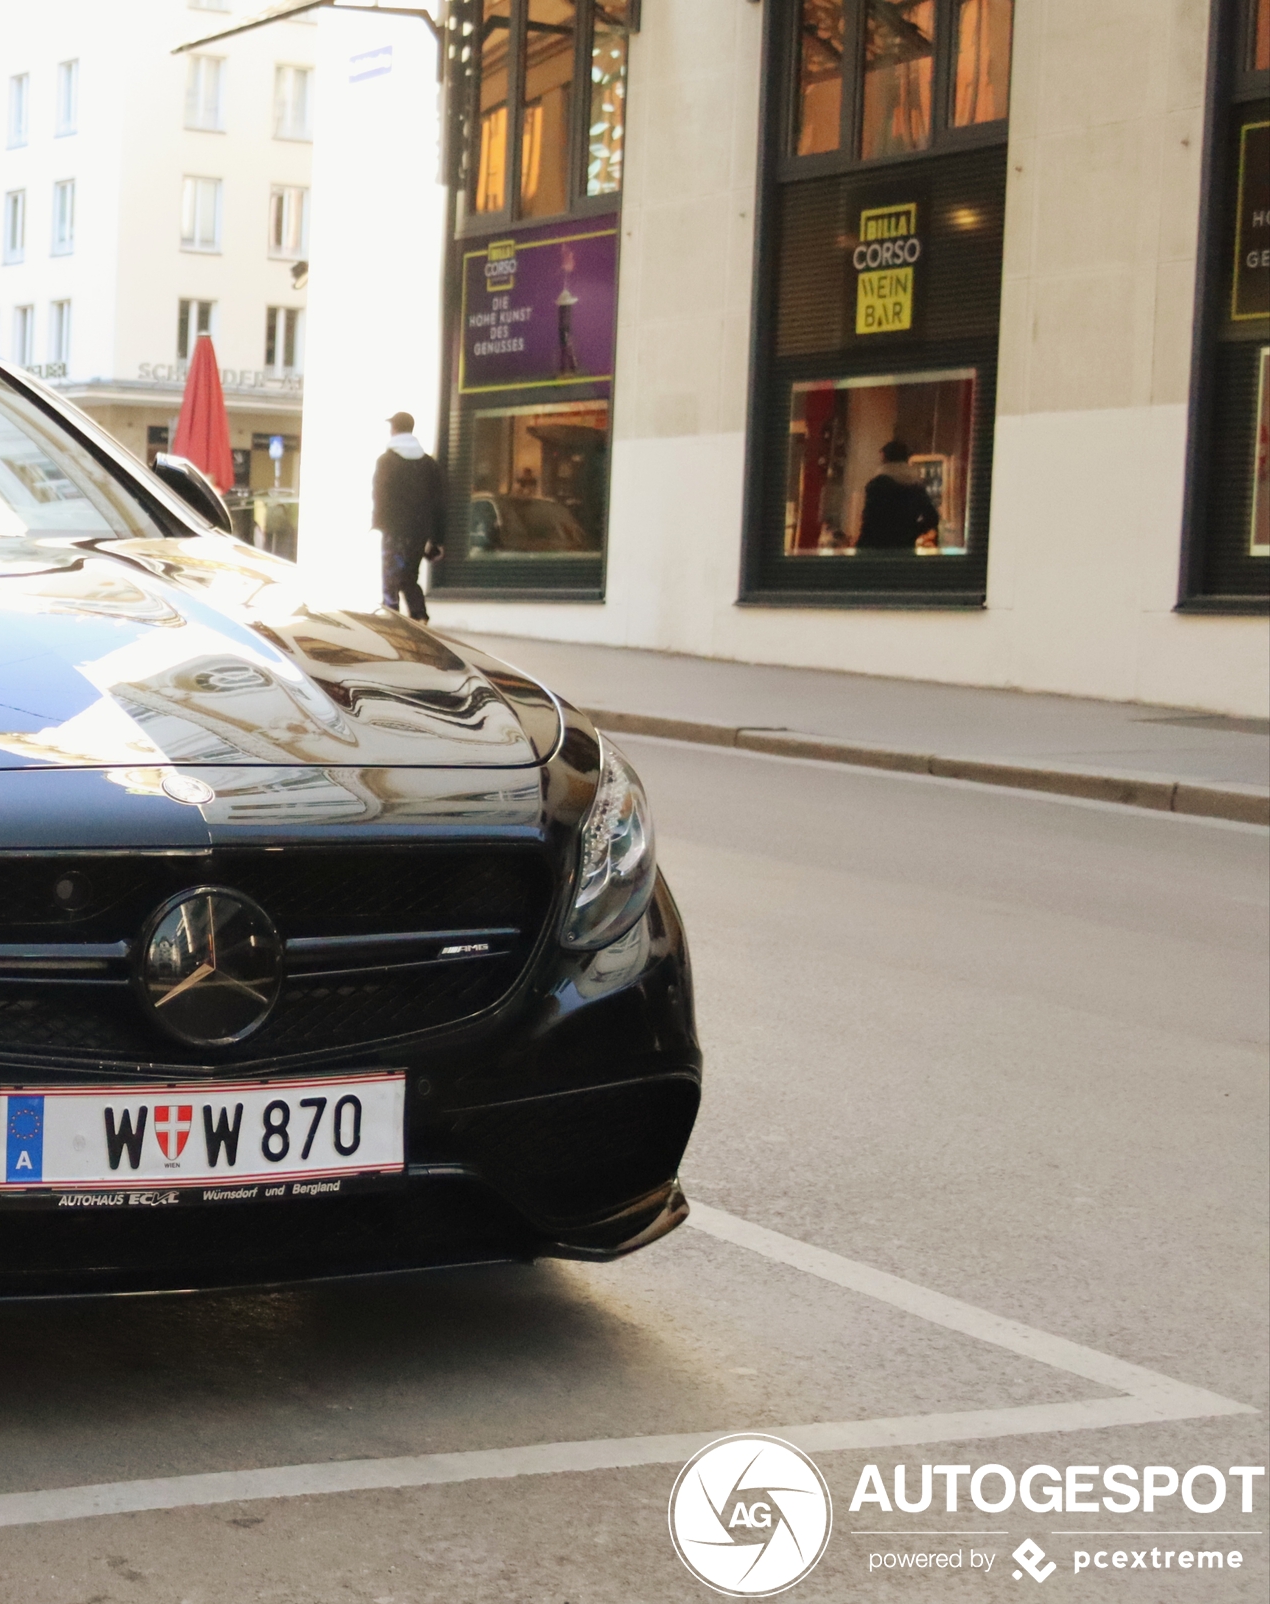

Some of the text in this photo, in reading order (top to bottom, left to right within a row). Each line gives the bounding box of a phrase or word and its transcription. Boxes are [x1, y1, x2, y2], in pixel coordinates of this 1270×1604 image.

[866, 214, 909, 241] BILLA
[853, 238, 921, 270] CORSO
[484, 259, 517, 277] CORSO
[492, 296, 510, 311] DIE
[469, 308, 532, 328] HOHE KUNST
[864, 302, 903, 328] BAR
[490, 325, 509, 339] DES
[473, 338, 525, 356] GENUSSES
[459, 943, 489, 953] AMG
[15, 1094, 362, 1171] A W W 870
[58, 1193, 124, 1207] AUTOHAUS
[202, 1186, 258, 1201] Würnsdorf
[265, 1185, 285, 1197] und
[292, 1180, 341, 1195] Bergland
